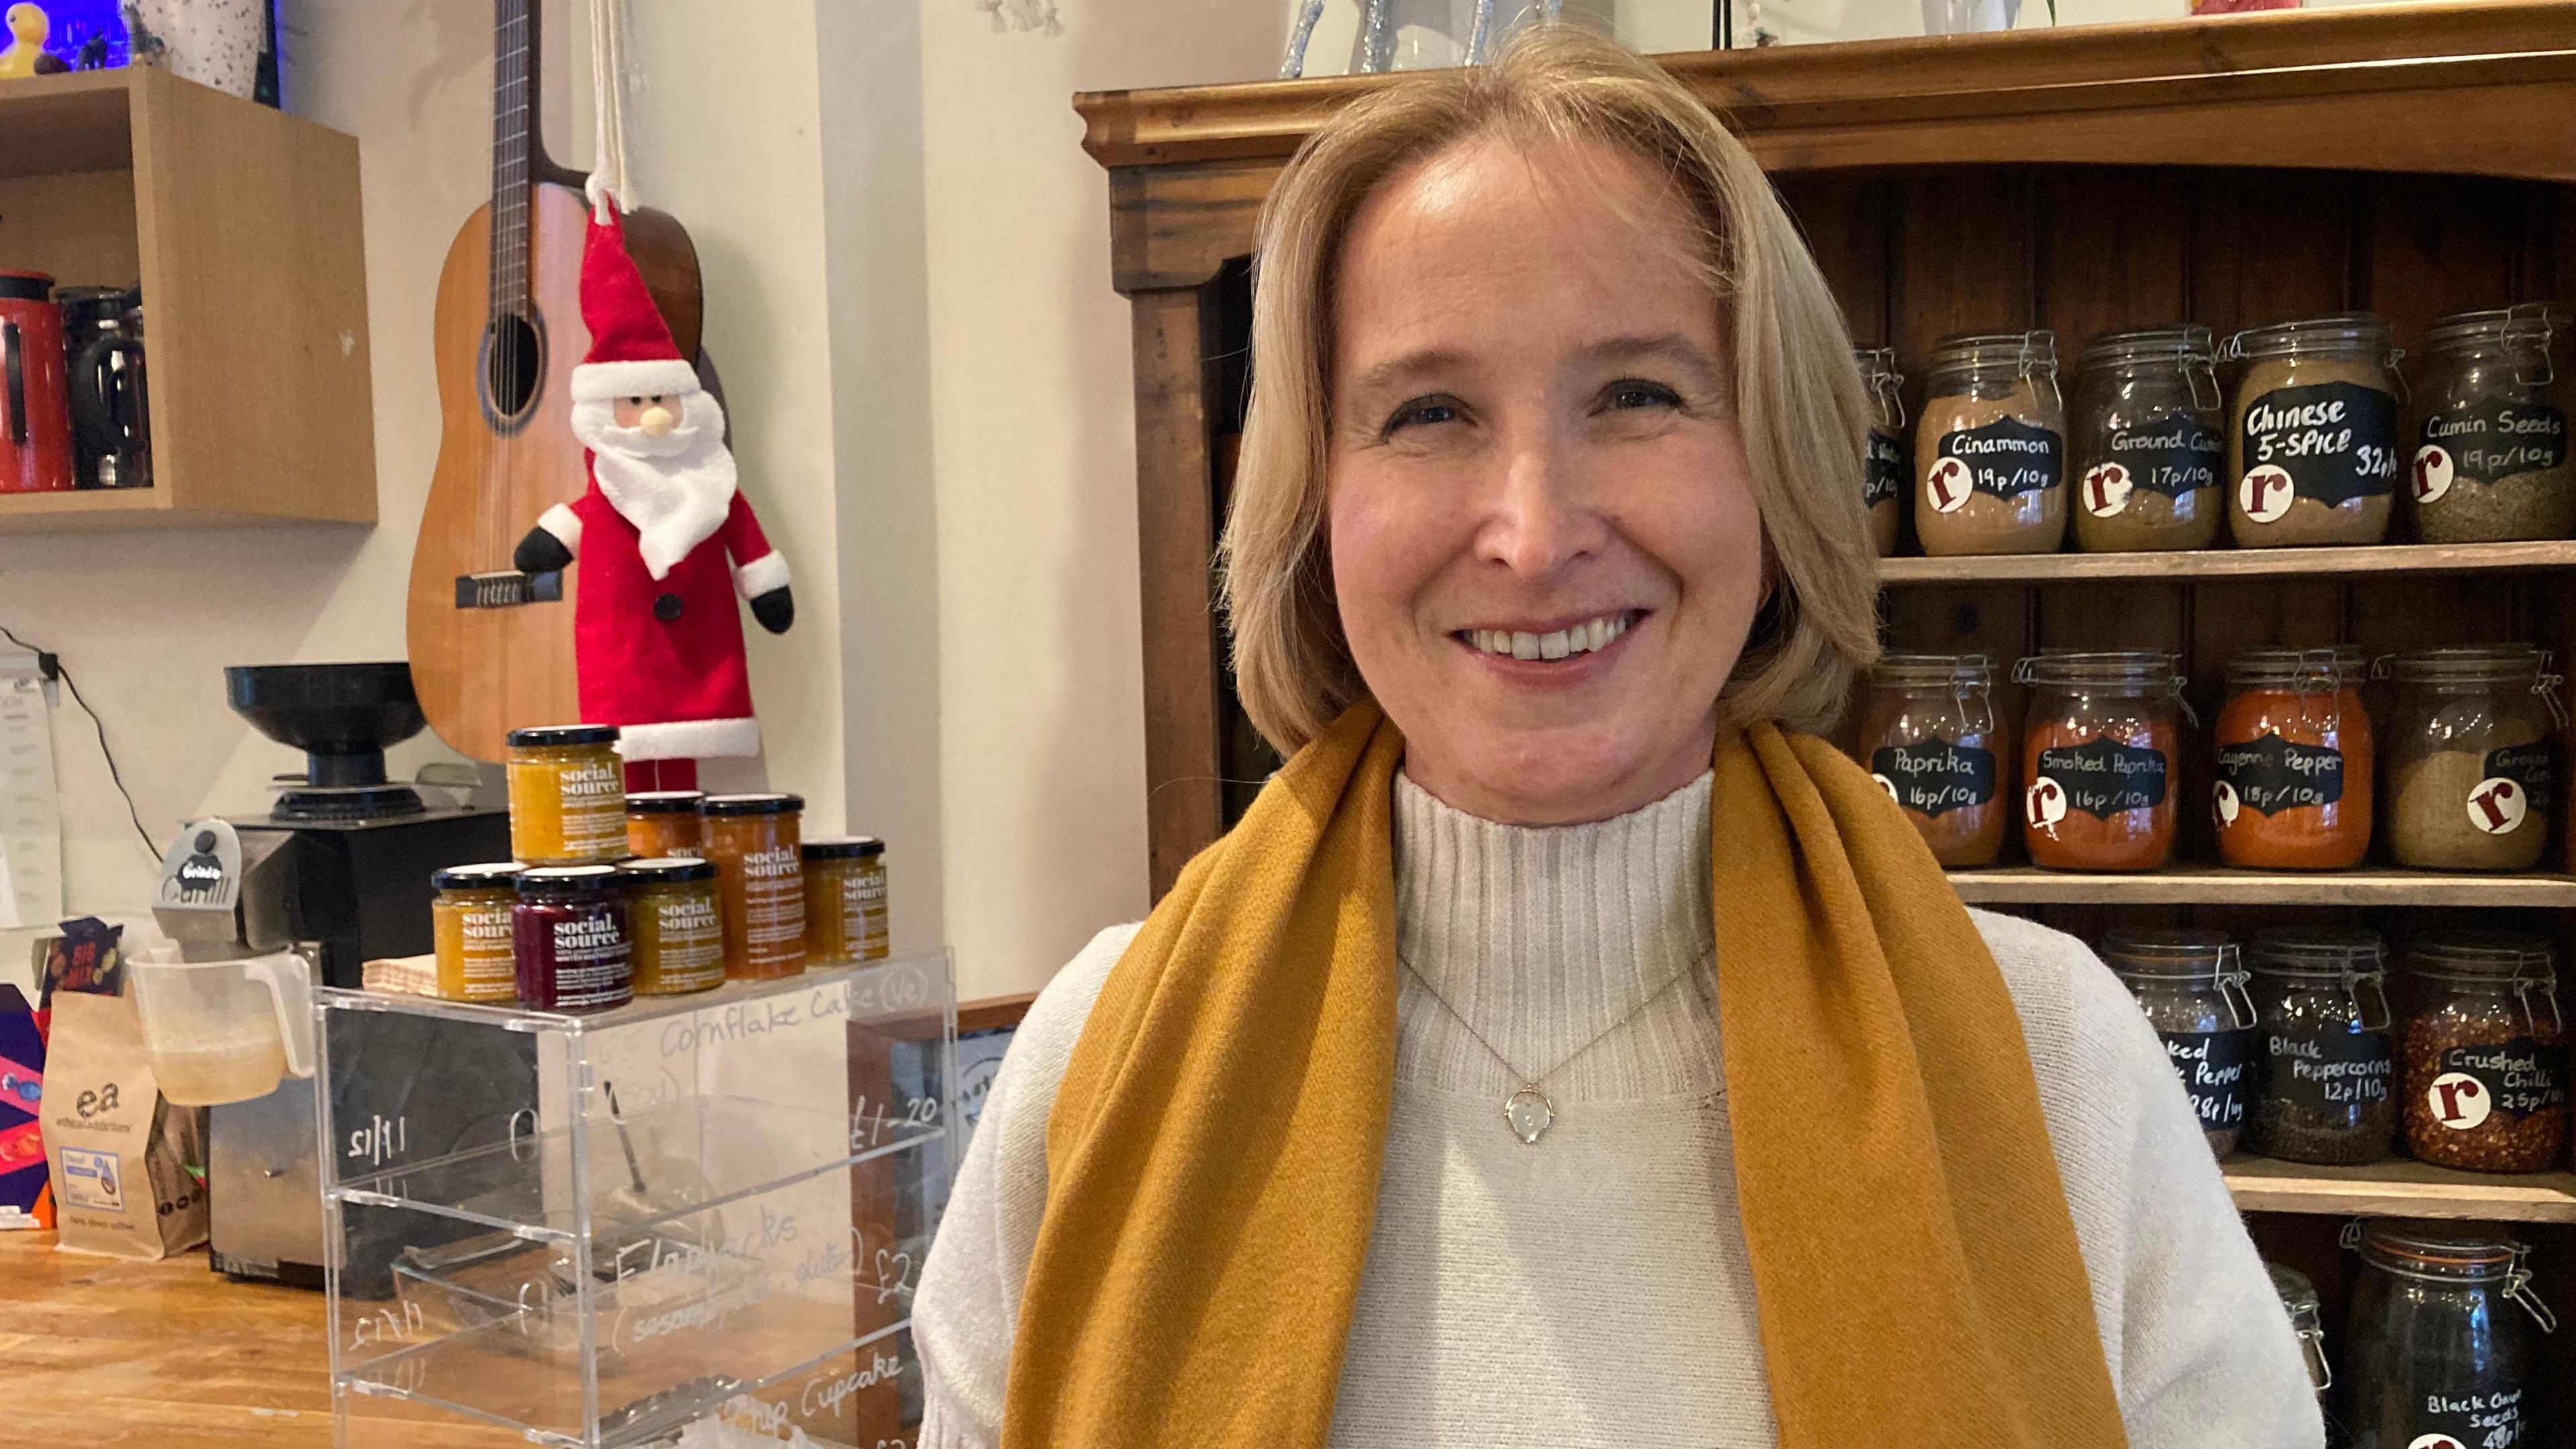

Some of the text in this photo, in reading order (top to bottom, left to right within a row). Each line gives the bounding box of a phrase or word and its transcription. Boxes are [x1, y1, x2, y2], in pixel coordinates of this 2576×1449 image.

[2428, 411, 2560, 437] Cumin Seeds
[1953, 435, 2049, 455] Cinammon
[2112, 430, 2185, 451] Ground
[2463, 447, 2554, 474] 19p/10g
[1978, 468, 2048, 491] 19p/10g
[2151, 467, 2212, 487] 17p/10g
[1894, 748, 1974, 778] Paprika
[2043, 751, 2165, 778] Smoked Paprika
[561, 780, 619, 796] source
[1911, 785, 1977, 810] 16p/10g
[2244, 786, 2324, 807] 18p/10g
[2076, 790, 2149, 811] 16p/10g
[745, 862, 800, 878] source
[659, 914, 716, 930] source
[554, 930, 620, 949] source
[660, 1002, 803, 1058] Cornflake
[810, 983, 875, 1019] Cake
[2270, 1036, 2322, 1059] Black
[2449, 1049, 2536, 1072] Crushed
[76, 1083, 120, 1118] ea
[2324, 1077, 2387, 1102] 12p/10g
[802, 1352, 903, 1417] Cupcake
[2428, 1395, 2485, 1413] Black
